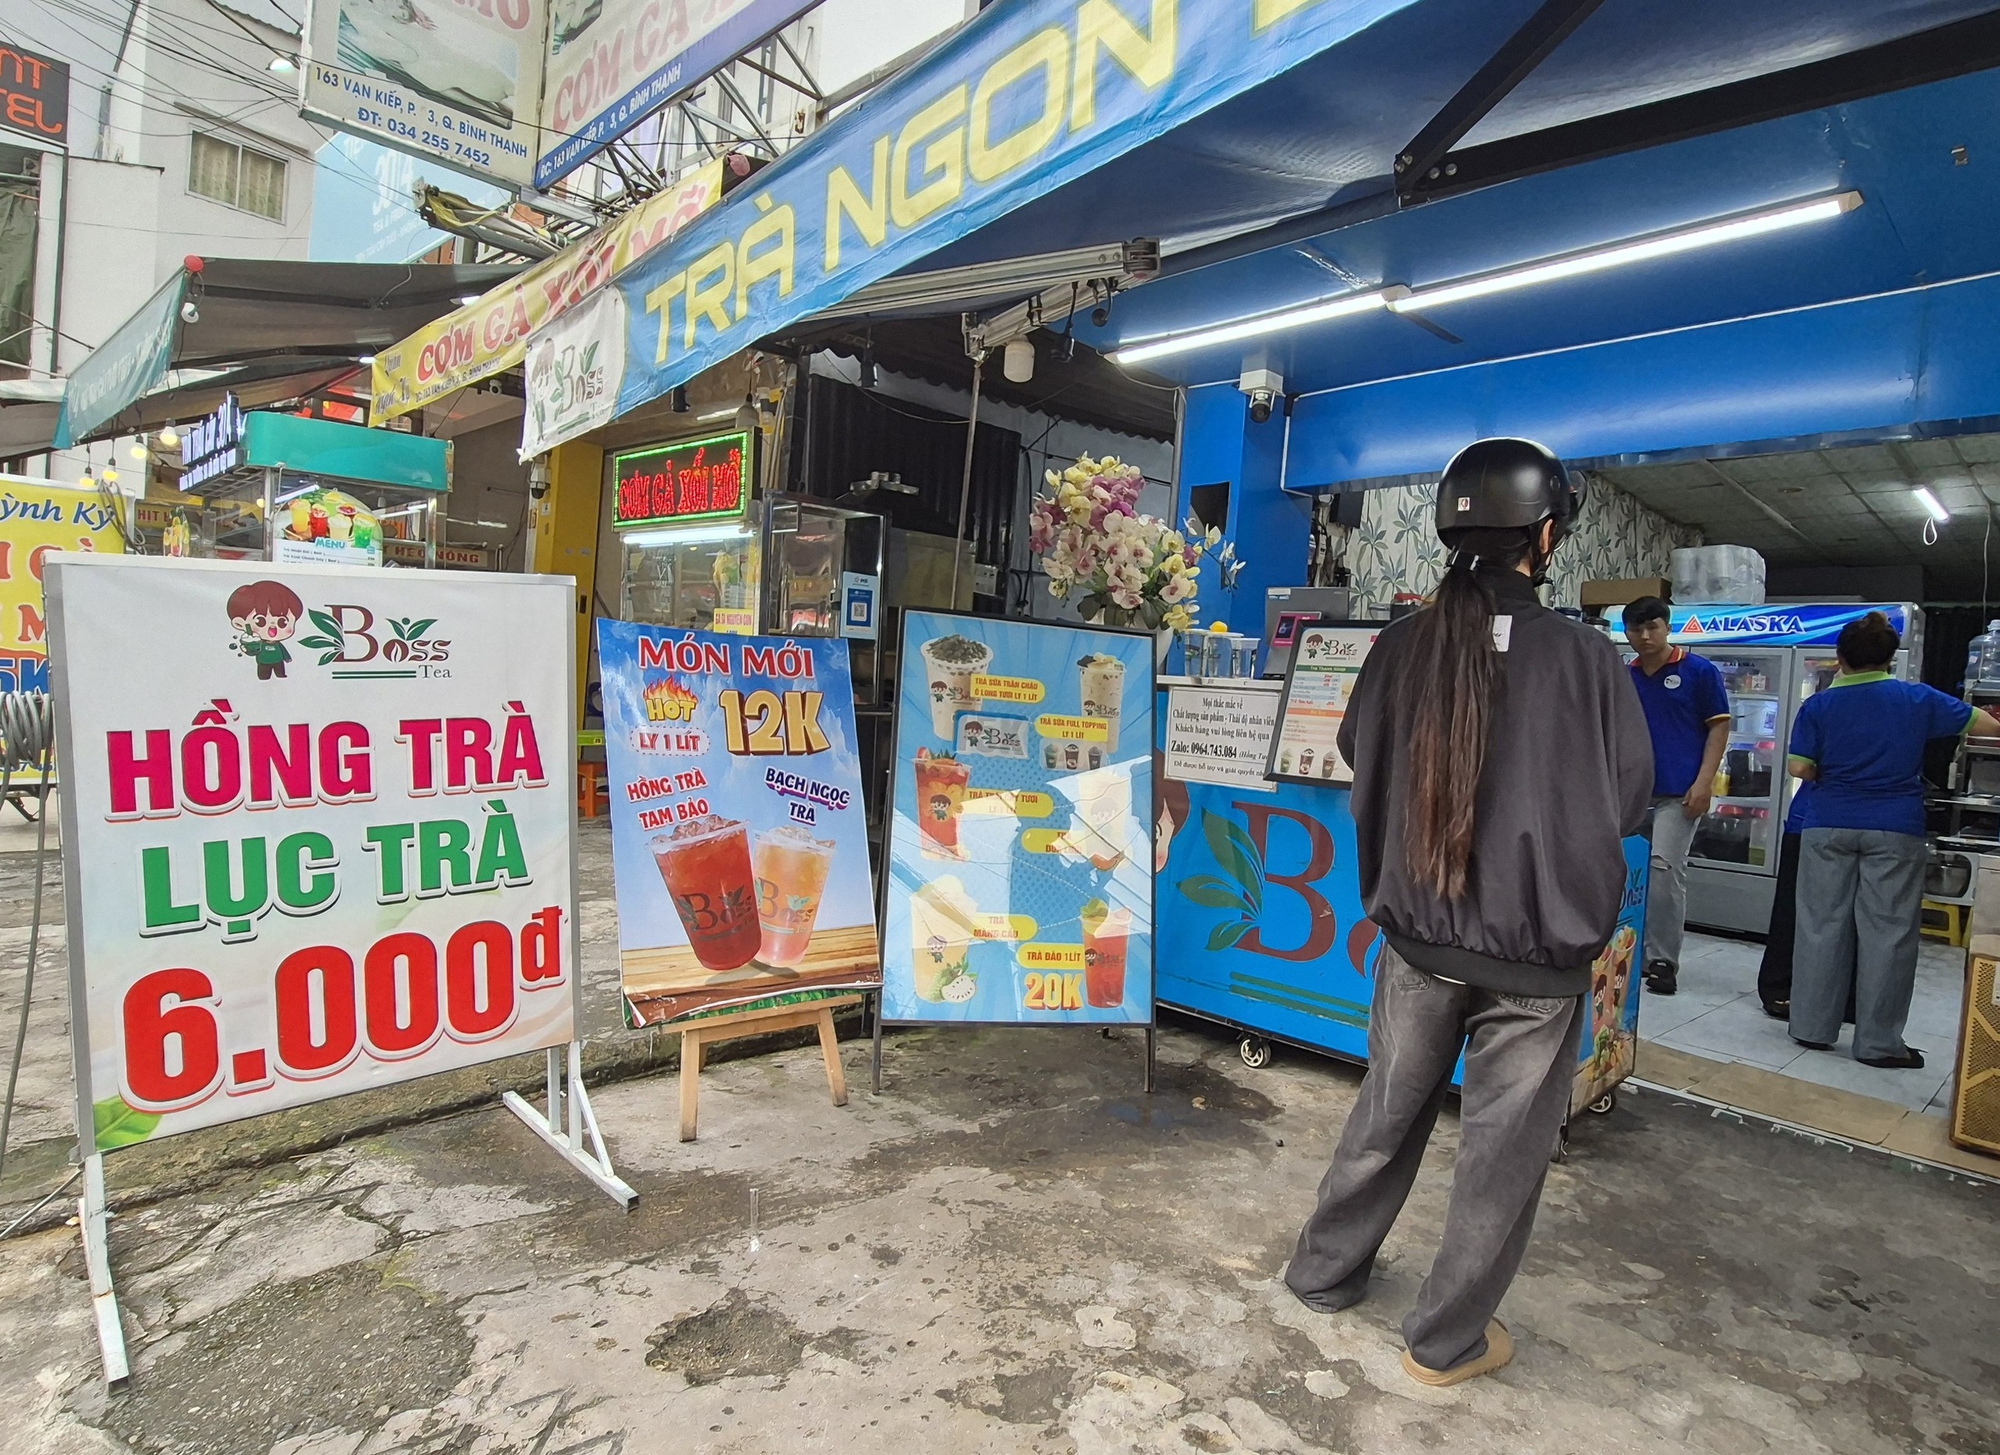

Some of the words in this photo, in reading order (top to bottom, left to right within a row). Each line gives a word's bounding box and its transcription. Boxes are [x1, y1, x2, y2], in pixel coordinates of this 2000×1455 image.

[315, 67, 339, 87] 163
[343, 76, 371, 99] VẠN
[375, 90, 403, 114] KIẾP,
[407, 101, 417, 117] P.
[442, 114, 455, 132] Q.
[459, 118, 487, 143] BÌNH
[490, 132, 528, 158] THẠNH
[553, 152, 565, 171] 163
[565, 138, 580, 163] VẠN
[618, 105, 628, 120] Q.
[629, 91, 650, 115] BÌNH
[650, 63, 681, 95] THẠNH
[357, 107, 382, 127] ĐT:
[387, 118, 417, 139] 034
[421, 131, 450, 152] 255
[454, 142, 491, 166] 7452
[645, 190, 796, 364] TRÀ
[823, 0, 1178, 275] NGON
[416, 321, 477, 384] CƠM
[619, 470, 651, 519] CƠM
[315, 538, 346, 549] MENU
[324, 604, 452, 662] Boss
[1707, 615, 1804, 633] ALASKA
[418, 665, 452, 679] Tea
[638, 633, 731, 676] MÓN
[742, 640, 815, 679] MỚI
[975, 678, 987, 686] TRÀ
[989, 678, 1002, 687] SỮA
[1003, 679, 1020, 688] TRÂN
[1021, 681, 1039, 690] CHÂU
[981, 689, 998, 698] LONG
[1015, 692, 1021, 700] LY
[1028, 693, 1037, 701] LÍT
[646, 697, 698, 722] HOT
[1173, 706, 1185, 718] Chất
[1210, 709, 1224, 723] phẩm
[1229, 713, 1240, 723] Thái
[1249, 715, 1262, 725] nhân
[1264, 716, 1274, 726] viên
[1202, 697, 1213, 709] Mọi
[719, 689, 831, 756] 12K
[1040, 717, 1051, 725] TRÀ
[1053, 718, 1065, 726] SỮA
[1066, 720, 1080, 728] FULL
[1082, 721, 1107, 730] TOPPING
[1075, 731, 1084, 739] LÍT
[1175, 723, 1194, 733] Khách
[1195, 724, 1209, 736] hàng
[1211, 727, 1220, 735] vui
[1222, 727, 1235, 738] lòng
[1236, 728, 1247, 738] liên
[1249, 730, 1256, 741] hệ
[1258, 733, 1270, 742] qua
[639, 733, 660, 749] LY
[664, 734, 670, 749] 1
[676, 730, 700, 751] LÍT
[1171, 740, 1189, 754] Zalo:
[1191, 742, 1237, 758] 0964.743.084
[106, 698, 374, 818] HỒNG
[397, 700, 548, 791] TRÀ
[627, 775, 672, 801] HỒNG
[674, 767, 707, 789] TRÀ
[765, 768, 810, 796] BẠCH
[809, 781, 850, 810] NGỌC
[639, 809, 674, 830] TAM
[677, 797, 709, 821] BẢO
[789, 801, 817, 823] TRÀ
[141, 832, 340, 942] LỤC
[363, 800, 531, 903] TRÀ
[1027, 951, 1043, 961] TRÀ
[120, 905, 565, 1112] 6.000đ
[1024, 973, 1085, 1011] 20K
